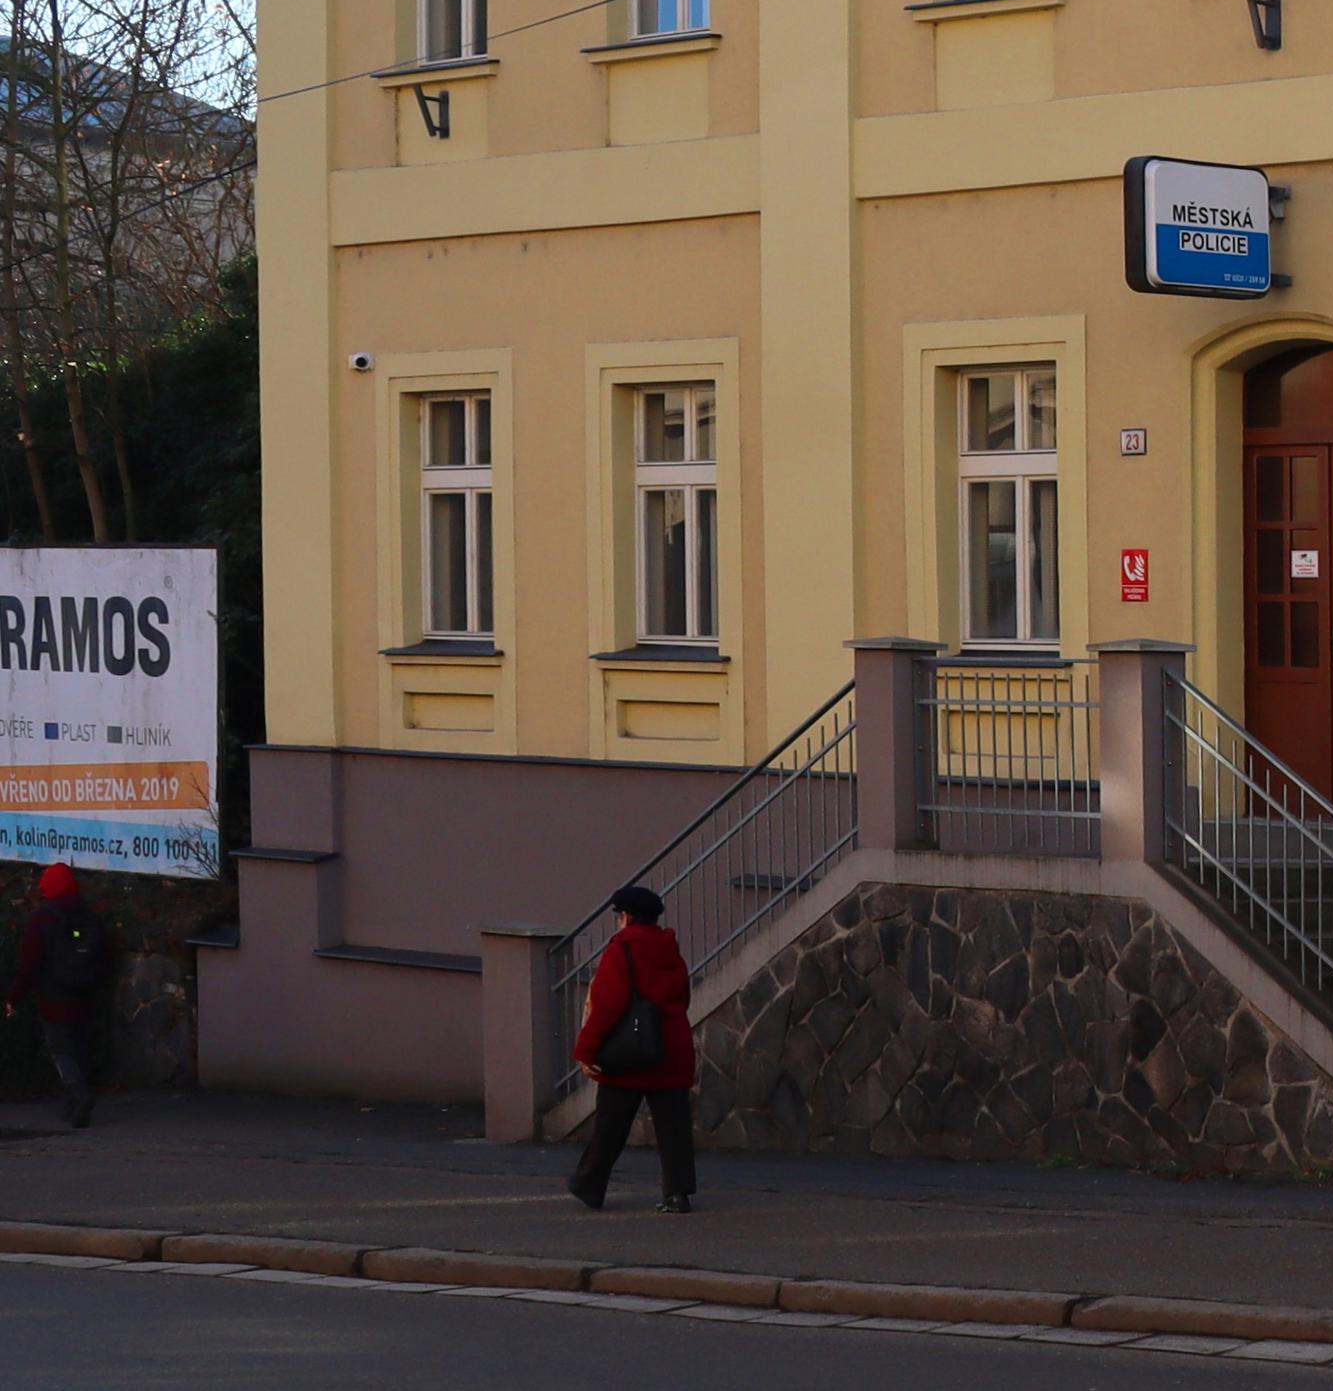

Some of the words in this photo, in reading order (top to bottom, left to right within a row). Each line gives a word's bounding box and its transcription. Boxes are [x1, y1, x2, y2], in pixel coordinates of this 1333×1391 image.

[1173, 201, 1253, 229] MĚSTSKÁ
[1181, 231, 1247, 254] POLICIE
[1125, 434, 1140, 450] 23
[0, 595, 171, 677] RAMOS
[62, 723, 96, 742] PLAST
[126, 723, 172, 746] HLINÍK
[0, 773, 49, 803] VŘENO
[52, 780, 71, 802] OD
[76, 772, 137, 802] BŘEZNA
[140, 777, 179, 802] 2019
[16, 825, 128, 858] kolin@pramos.cz,
[133, 836, 159, 858] 800
[164, 838, 189, 860] 100
